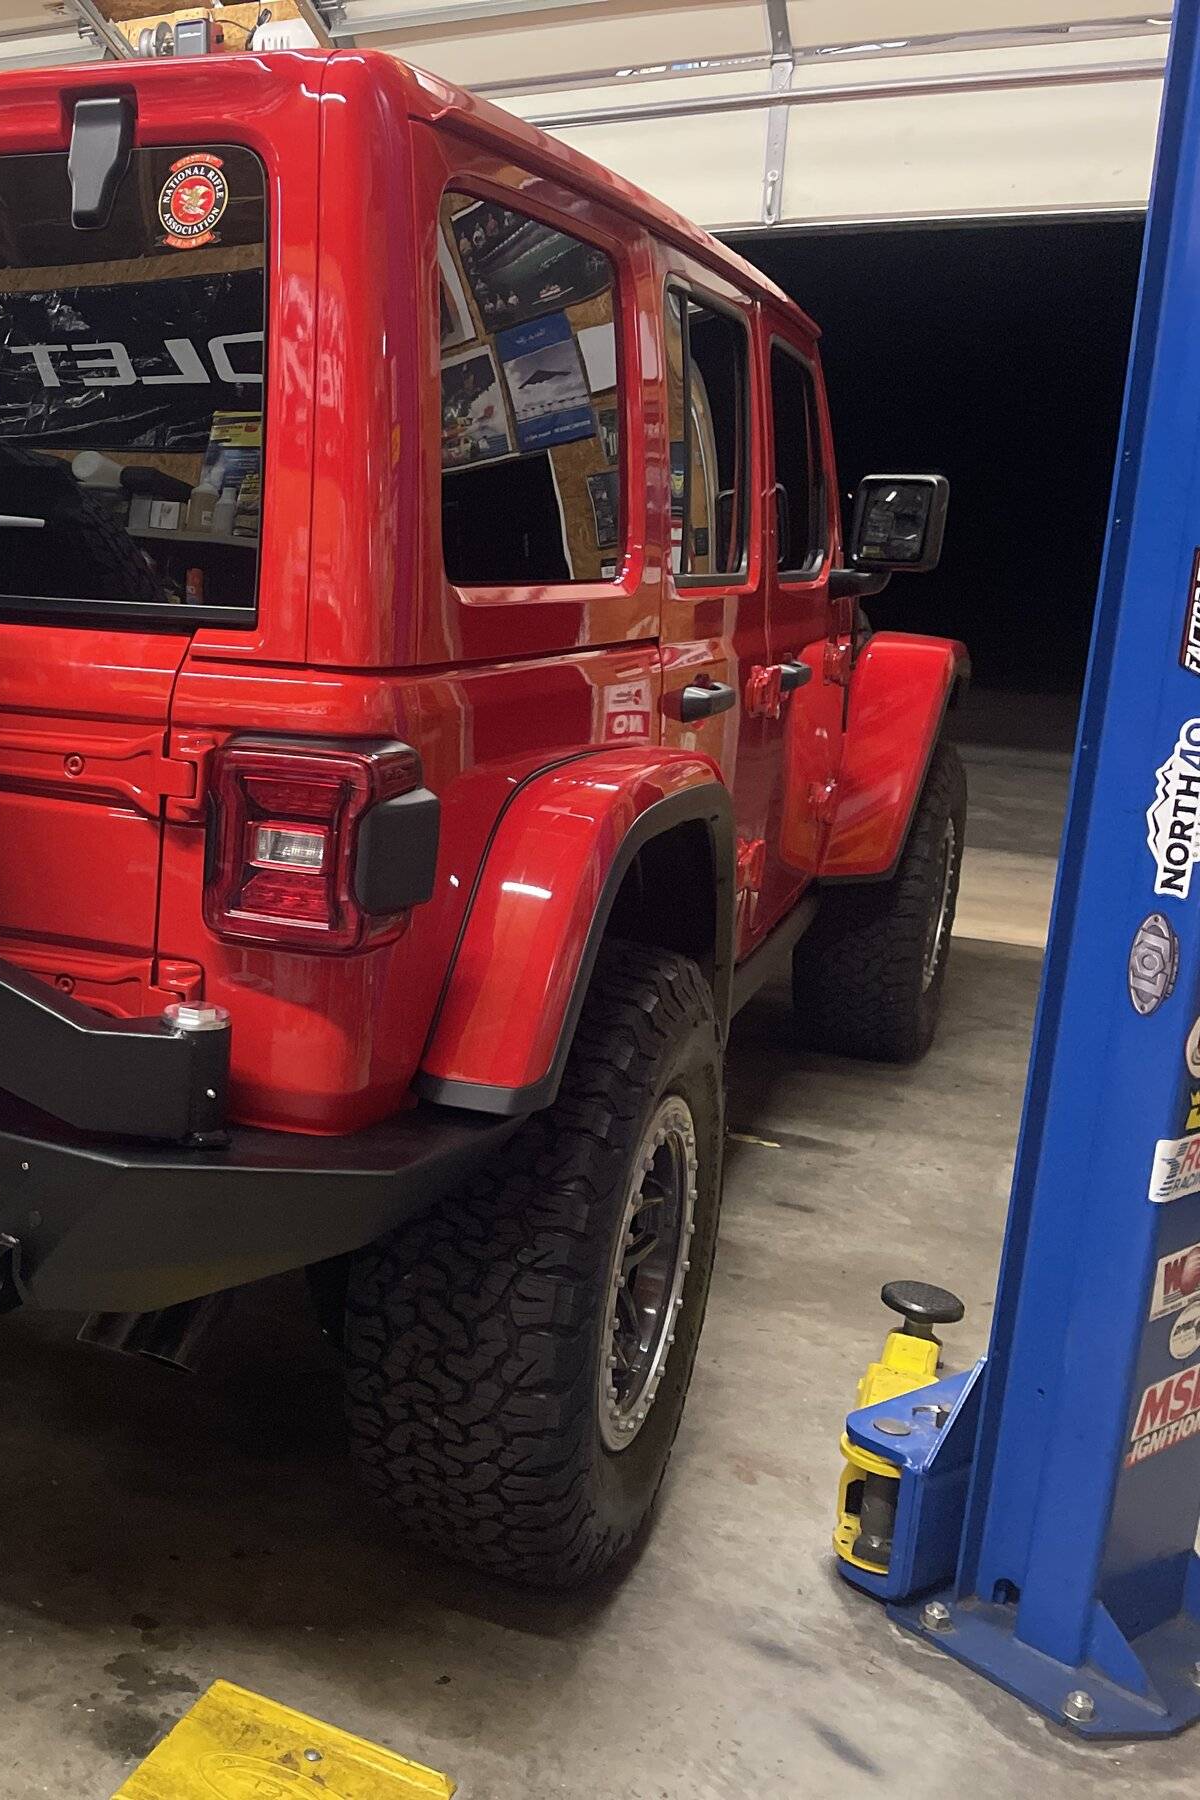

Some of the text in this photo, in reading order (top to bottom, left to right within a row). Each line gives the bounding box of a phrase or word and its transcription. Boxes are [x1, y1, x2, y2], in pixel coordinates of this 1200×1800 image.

[163, 166, 224, 204] NATIONAL RIFLE
[163, 206, 220, 235] ASSOCIATION
[1160, 773, 1200, 892] NORTH
